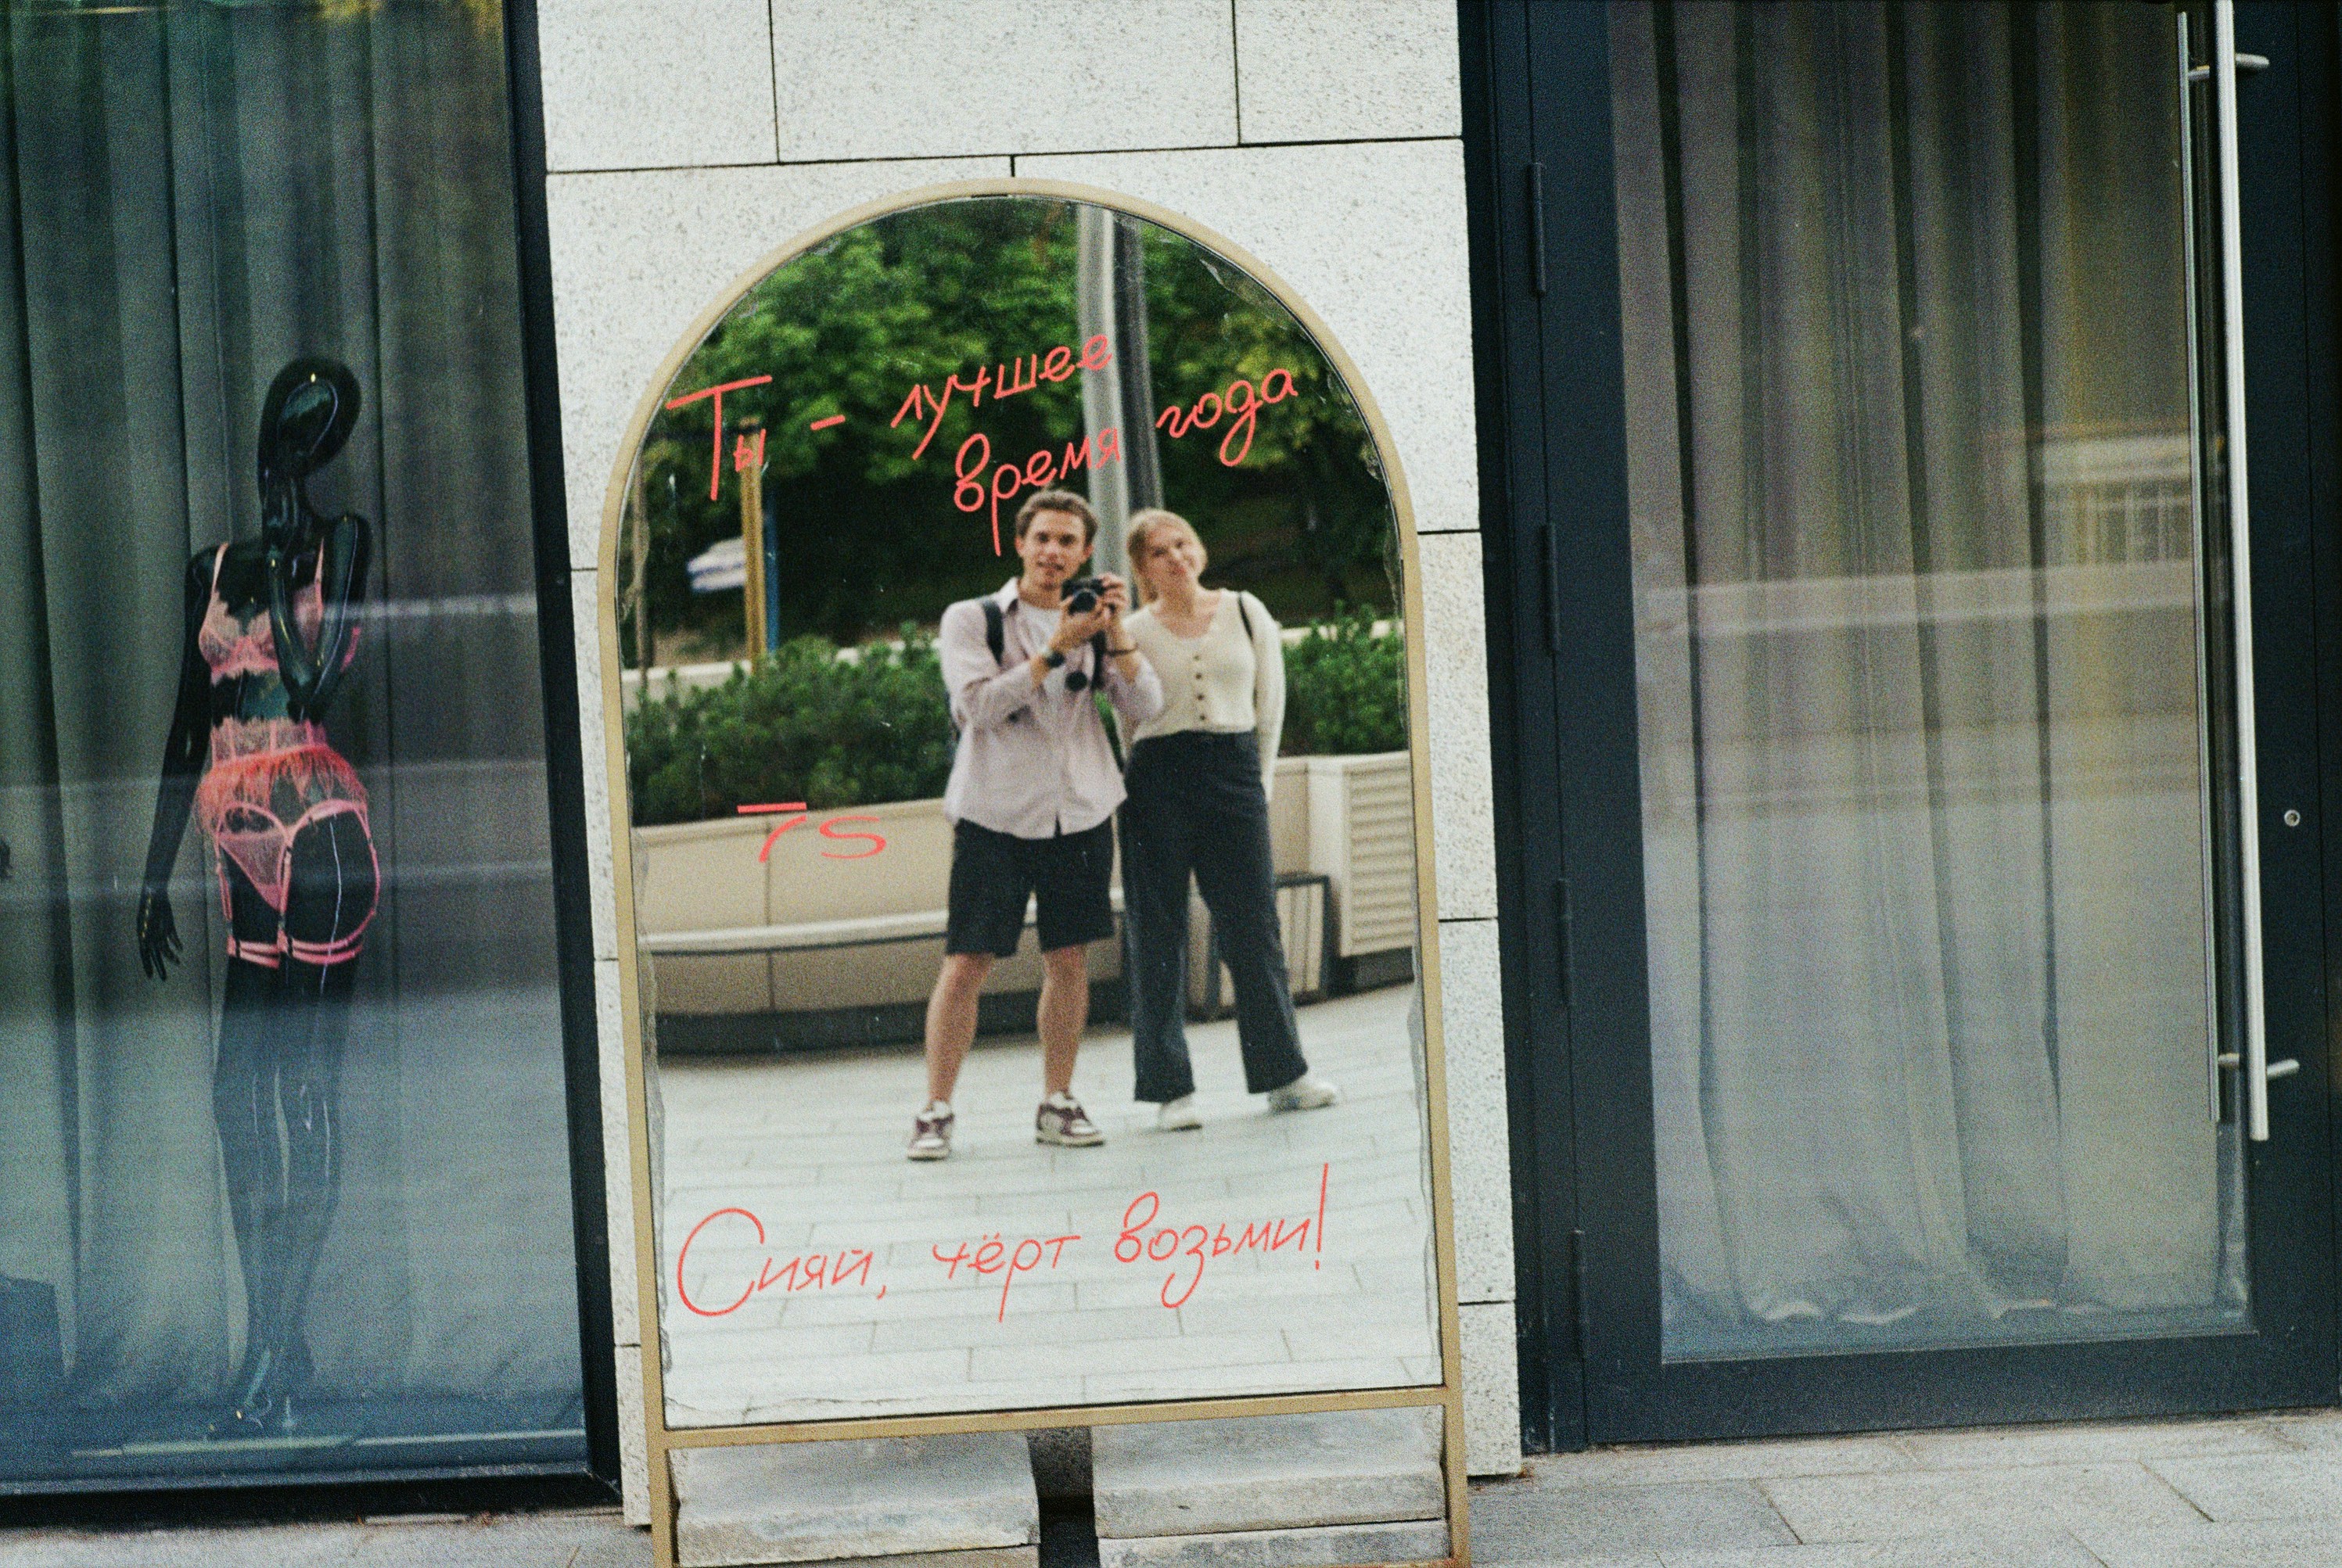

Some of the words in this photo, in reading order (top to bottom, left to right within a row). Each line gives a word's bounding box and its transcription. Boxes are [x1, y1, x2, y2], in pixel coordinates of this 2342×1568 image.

[666, 375, 772, 501] Ты
[890, 332, 1113, 460] лучшее
[954, 427, 1122, 556] время
[1155, 368, 1299, 467] года
[677, 1207, 887, 1317] Сияй,
[932, 1233, 1081, 1322] чёрт
[1114, 1162, 1329, 1308] возьми!
